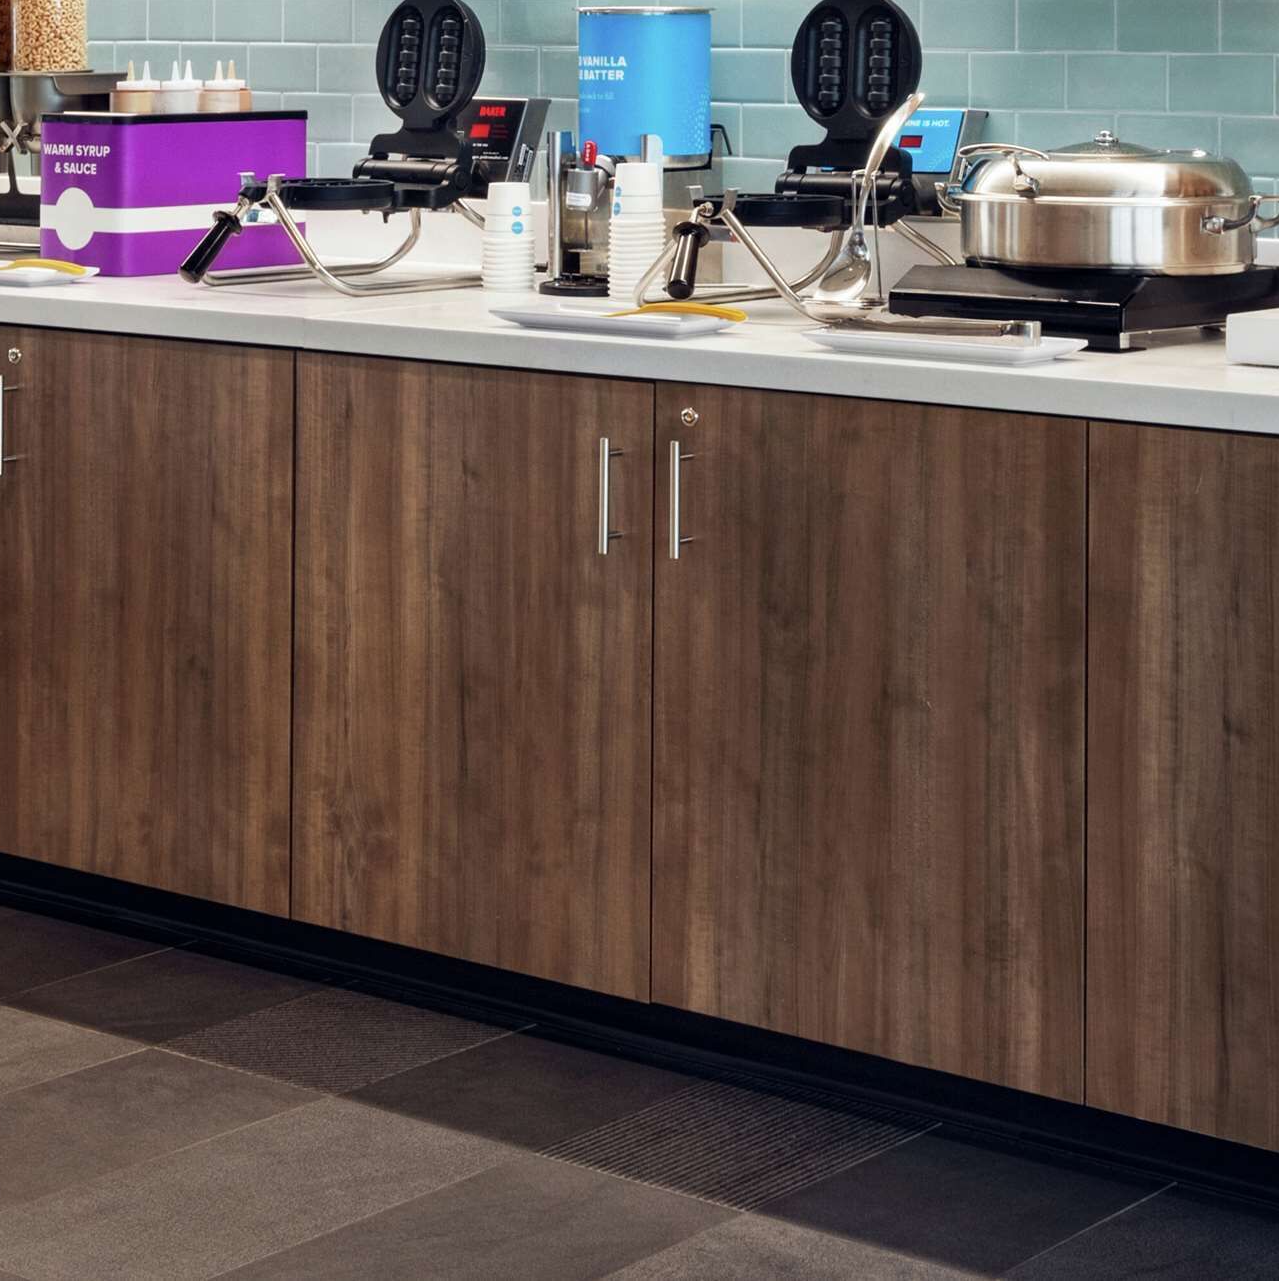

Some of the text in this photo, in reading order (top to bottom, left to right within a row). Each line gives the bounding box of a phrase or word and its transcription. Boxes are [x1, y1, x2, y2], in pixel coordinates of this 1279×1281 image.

[583, 56, 628, 67] VANILLA
[584, 69, 625, 81] BATTER
[43, 143, 111, 158] WARM SYRUP
[54, 161, 97, 175] & SAUCE
